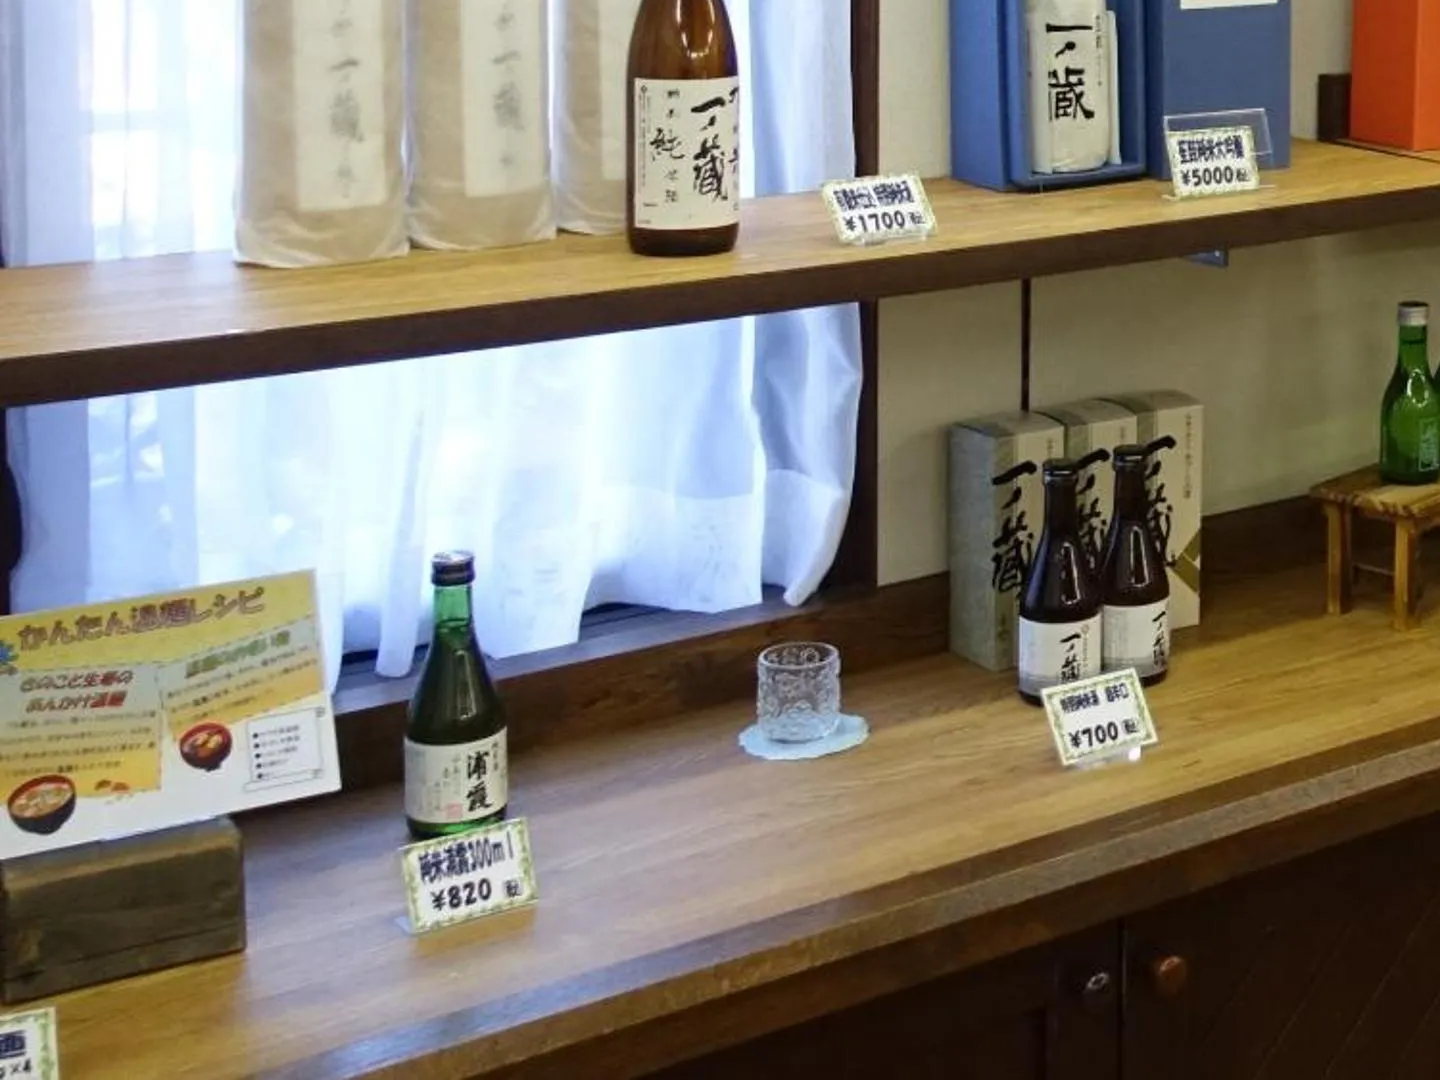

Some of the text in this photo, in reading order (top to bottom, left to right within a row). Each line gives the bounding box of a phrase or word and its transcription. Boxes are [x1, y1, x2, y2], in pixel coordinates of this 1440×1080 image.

[1046, 22, 1095, 122] 一ノ蔵
[690, 95, 730, 202] 一ノ蔵
[1181, 166, 1234, 187] ¥5000
[843, 210, 905, 233] ¥1700
[1068, 721, 1119, 749] ¥700
[430, 877, 492, 911] ¥820
